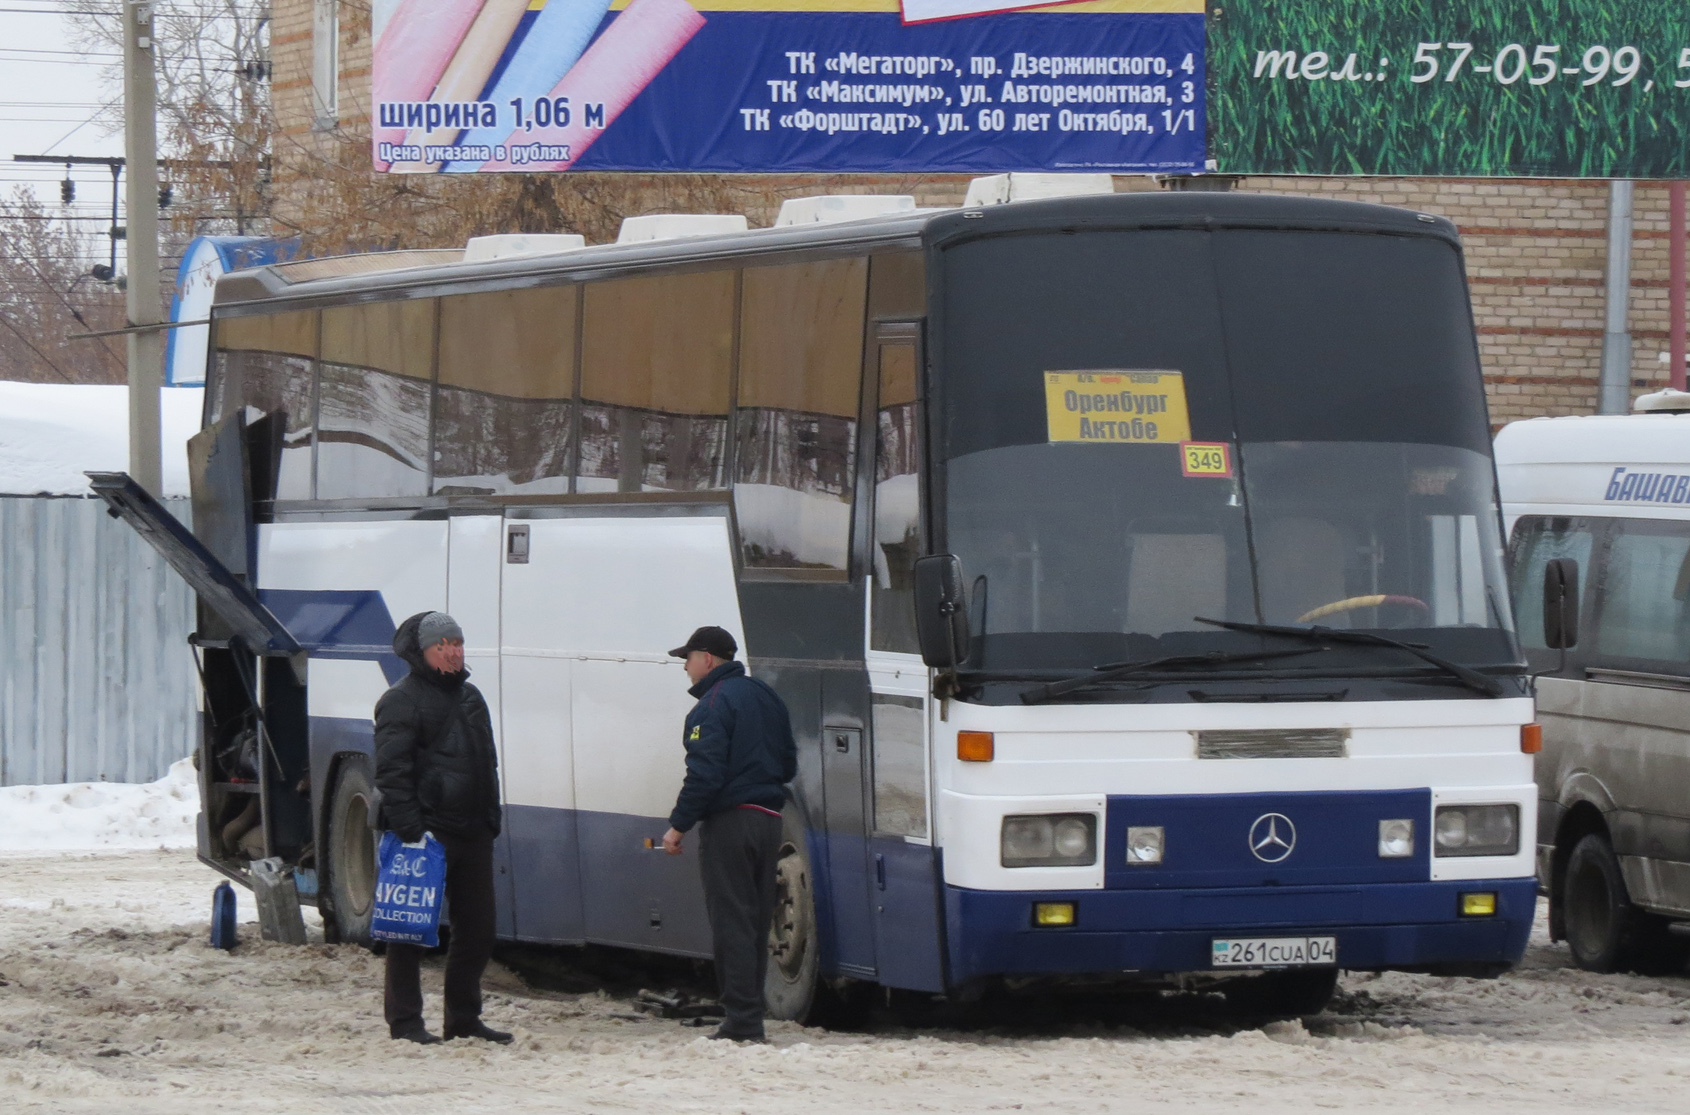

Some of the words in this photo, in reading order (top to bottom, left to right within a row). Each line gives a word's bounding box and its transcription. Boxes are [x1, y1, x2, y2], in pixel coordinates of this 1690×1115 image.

[785, 51, 816, 74] ТК
[824, 52, 962, 79] «Мегаторг»,
[970, 56, 1003, 79] пр.
[1010, 52, 1173, 79] Дзержинского,
[1180, 52, 1194, 75] 4
[1253, 49, 1389, 82] тел.:
[1410, 42, 1655, 93] 57-05-99,
[766, 80, 798, 102] ТК
[806, 80, 952, 107] «Максимум»,
[959, 84, 993, 107] ул.
[1001, 80, 1173, 107] Авторемонтная,
[1181, 81, 1195, 103] 3
[379, 102, 497, 133] ширина
[510, 97, 571, 132] 1,06
[584, 103, 604, 128] м
[739, 108, 771, 131] ТК
[779, 108, 930, 136] «Форштадт»,
[937, 112, 970, 136] ул.
[978, 109, 1005, 131] 60
[1012, 112, 1051, 131] лет
[1058, 108, 1154, 136] Октября,
[1161, 109, 1195, 136] 1/1
[379, 144, 420, 164] Цена
[426, 147, 490, 164] указана
[497, 147, 506, 161] в
[512, 144, 570, 164] рублях
[1064, 389, 1168, 415] Оренбург
[1079, 417, 1158, 440] Актобе
[1189, 451, 1222, 470] 349
[1214, 954, 1228, 963] KZ
